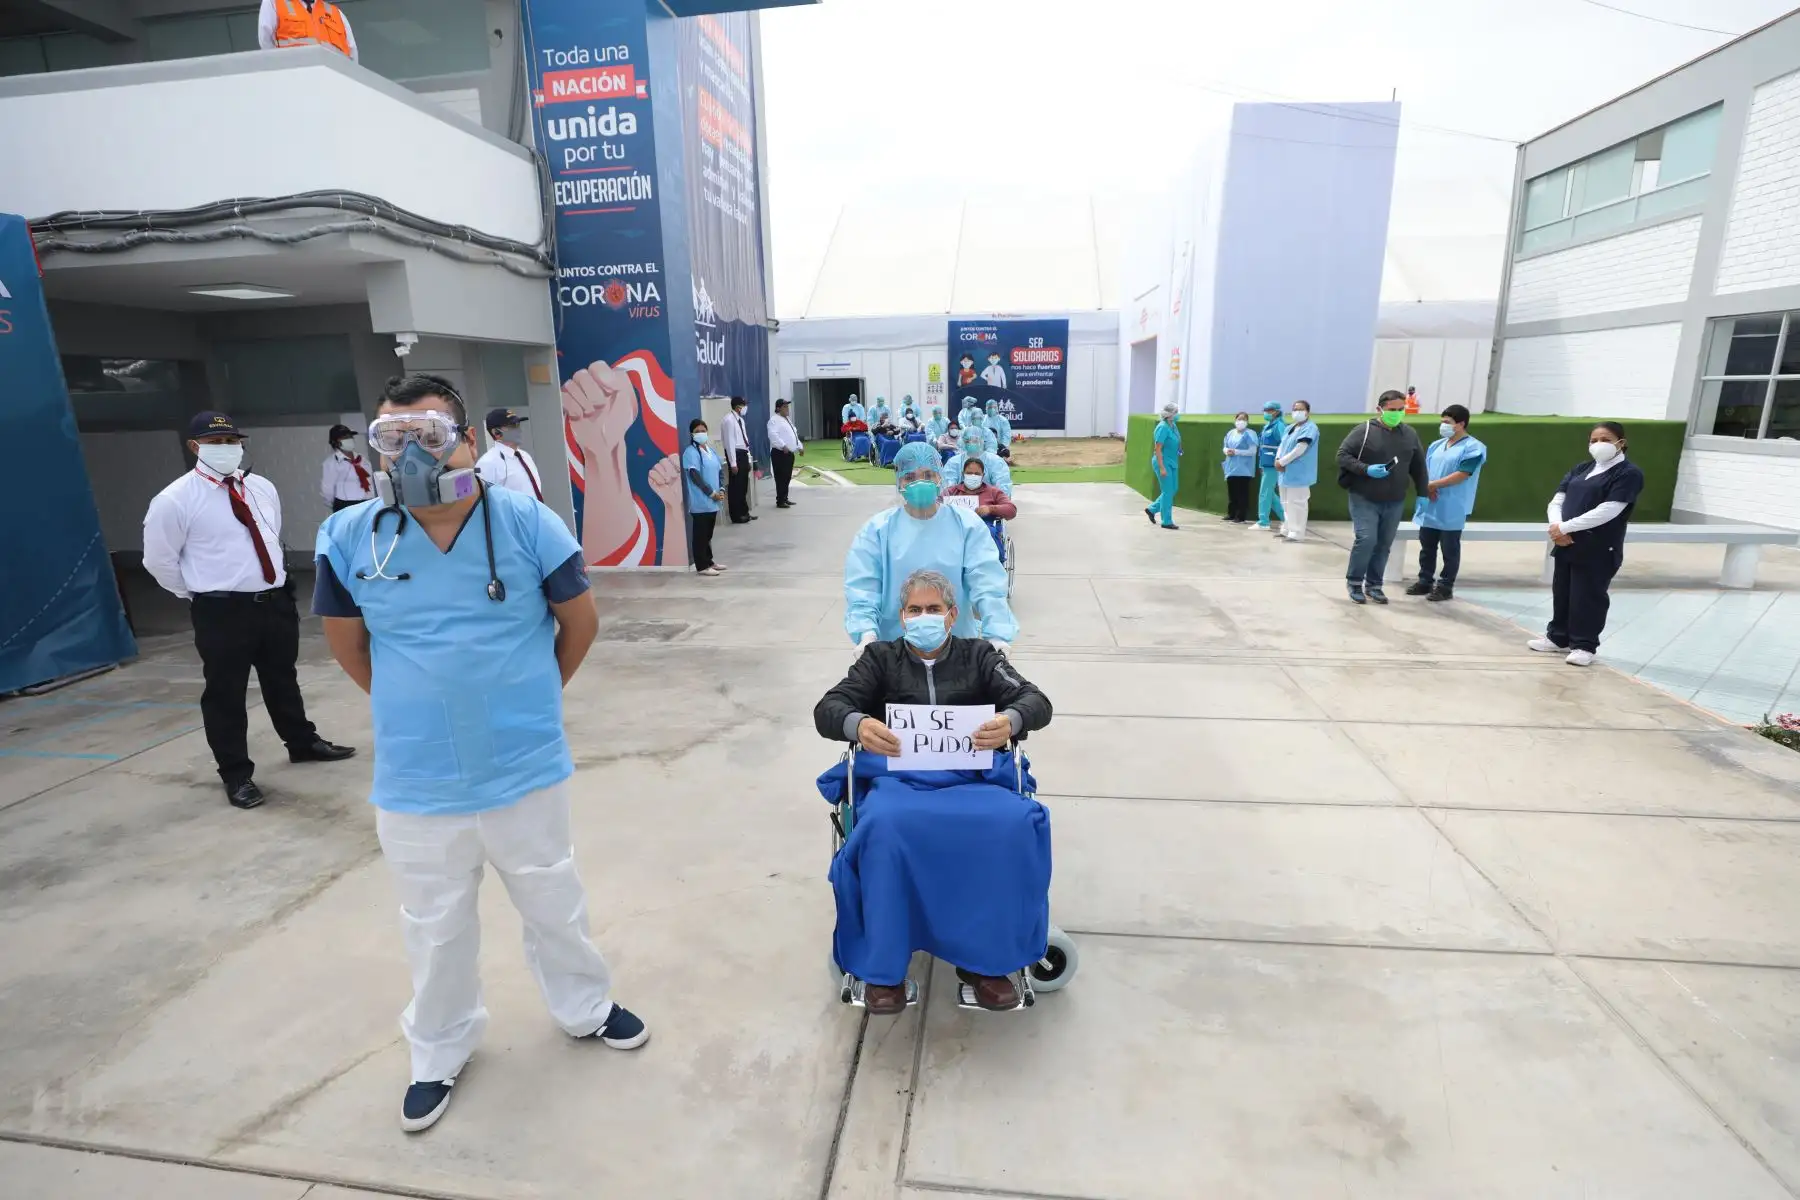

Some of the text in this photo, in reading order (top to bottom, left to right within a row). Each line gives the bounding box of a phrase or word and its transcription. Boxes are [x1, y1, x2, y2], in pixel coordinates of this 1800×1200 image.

[543, 44, 629, 67] Toda una
[552, 71, 626, 97] NACIÓN
[547, 105, 637, 141] unida
[564, 141, 625, 169] por tu
[554, 170, 652, 206] ECUPERACIÓN
[558, 262, 660, 278] UNTOS CONTRA EL
[629, 303, 660, 319] virus
[1028, 337, 1044, 349] SER
[1013, 350, 1060, 362] SOLIDARIOS
[1021, 379, 1054, 387] pandemia
[930, 709, 955, 731] SE
